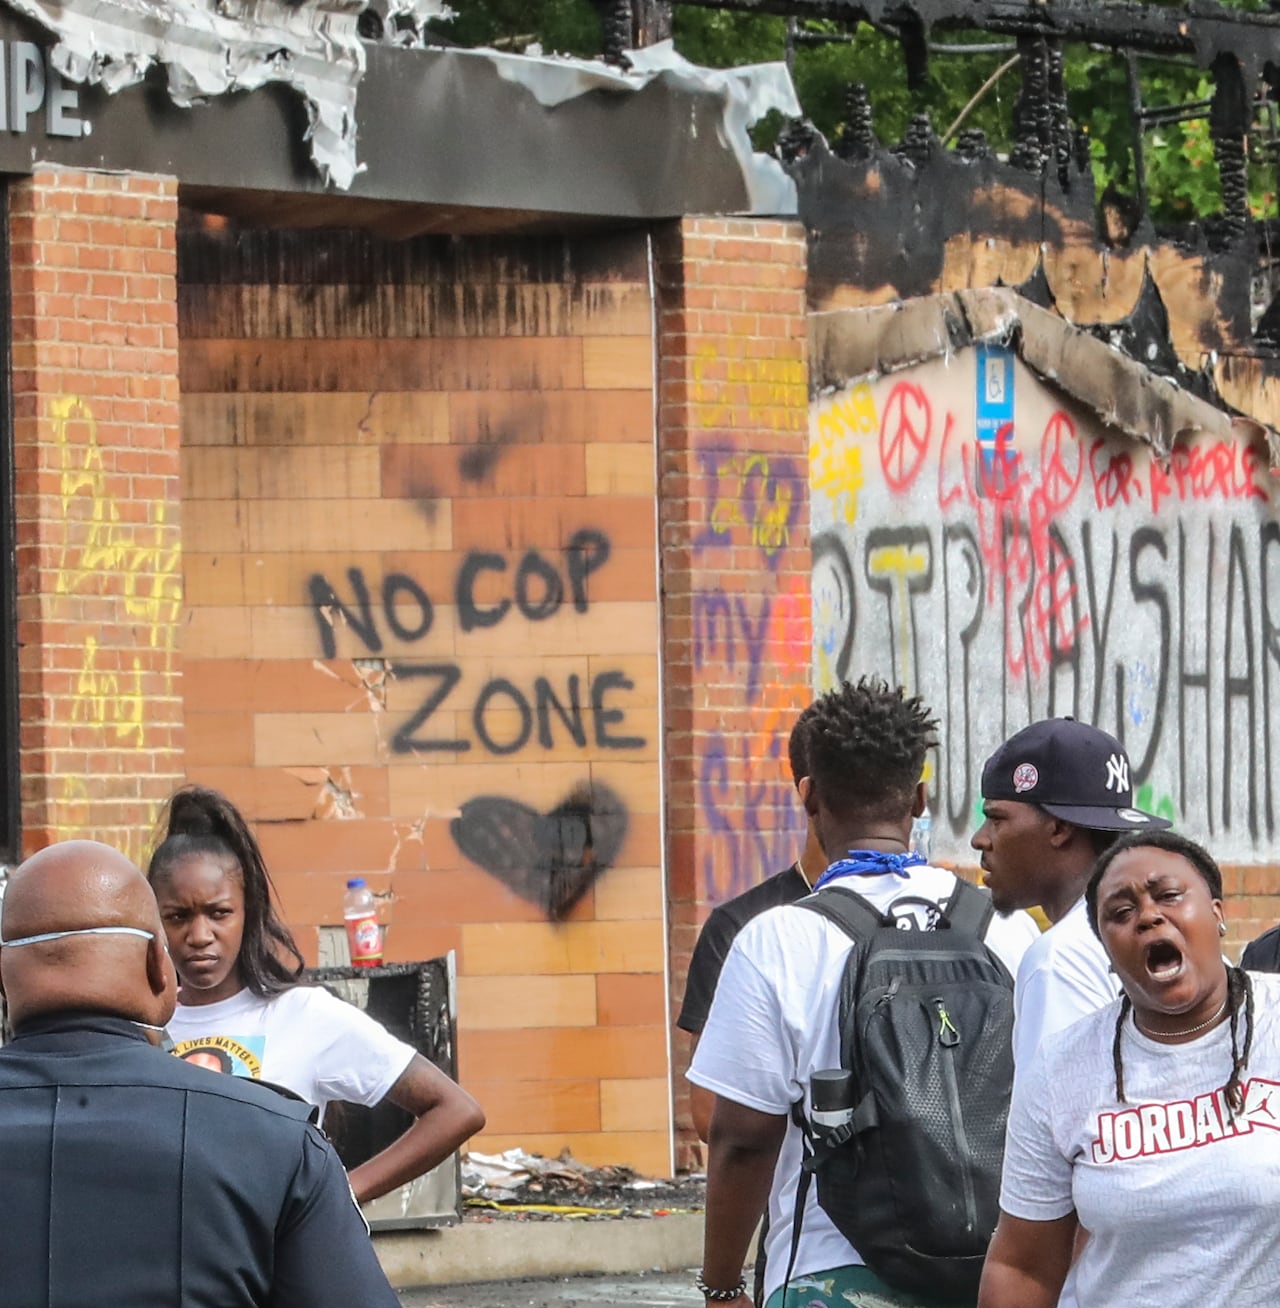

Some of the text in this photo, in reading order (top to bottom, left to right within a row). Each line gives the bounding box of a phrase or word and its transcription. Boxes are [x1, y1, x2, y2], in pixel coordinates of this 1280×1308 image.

[307, 528, 612, 660] NO COP
[694, 588, 772, 703] MY
[392, 663, 647, 756] ZONE
[183, 1036, 211, 1051] LIVES
[1092, 1083, 1253, 1163] JORDAN
